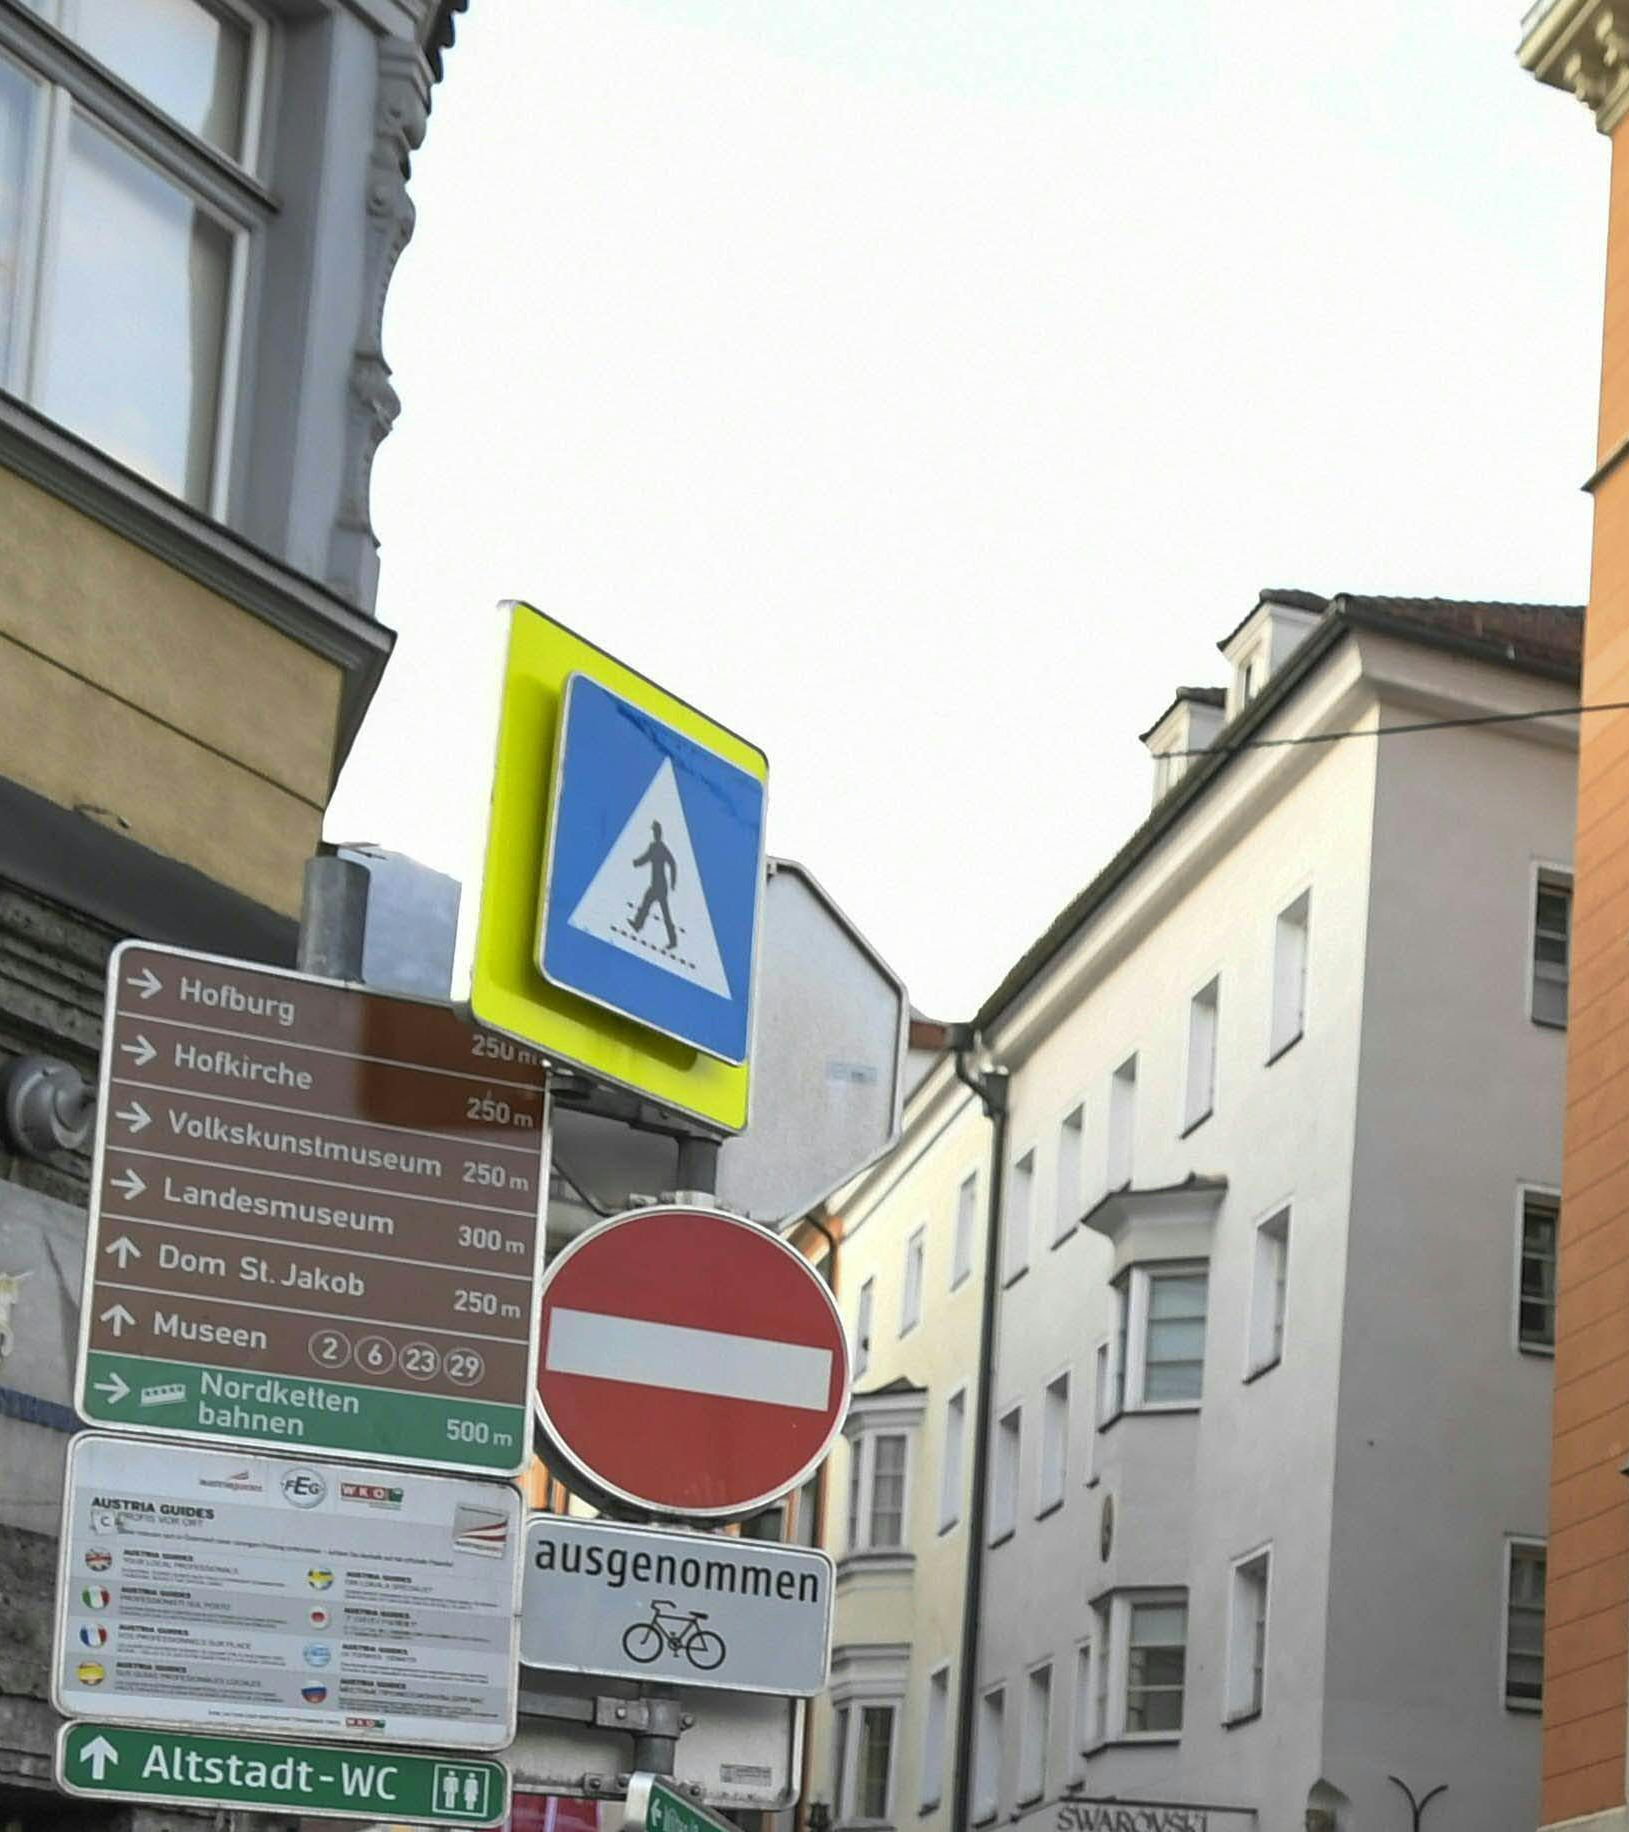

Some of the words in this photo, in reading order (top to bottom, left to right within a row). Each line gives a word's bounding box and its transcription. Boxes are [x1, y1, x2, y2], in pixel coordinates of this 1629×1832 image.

[180, 979, 295, 1025] Hofburg
[471, 1034, 513, 1062] 250
[174, 1044, 313, 1090] Hofkirche
[466, 1097, 510, 1124] 250
[514, 1113, 534, 1129] m
[169, 1110, 442, 1177] Volkskunstmuseum
[463, 1161, 506, 1187] 250
[509, 1176, 529, 1191] m
[164, 1177, 395, 1235] Landesmuseum
[458, 1226, 501, 1251] 300
[505, 1239, 525, 1255] m
[159, 1245, 225, 1277] Dom
[239, 1257, 275, 1286] St.
[281, 1264, 365, 1297] Jakob
[454, 1290, 497, 1315] 250
[500, 1303, 521, 1319] m
[154, 1313, 267, 1349] Museen
[323, 1338, 338, 1361] 2
[368, 1344, 382, 1366] 6
[405, 1349, 436, 1373] 23
[450, 1354, 480, 1378] 29
[199, 1401, 304, 1436] bahnen
[200, 1373, 359, 1414] Nordketten
[446, 1420, 489, 1444] 500
[492, 1431, 513, 1447] m
[92, 1497, 155, 1513] AUSTRIA
[160, 1504, 215, 1520] GUIDES
[536, 1538, 820, 1603] ausgenommen
[143, 1743, 399, 1802] Altstadt-WC
